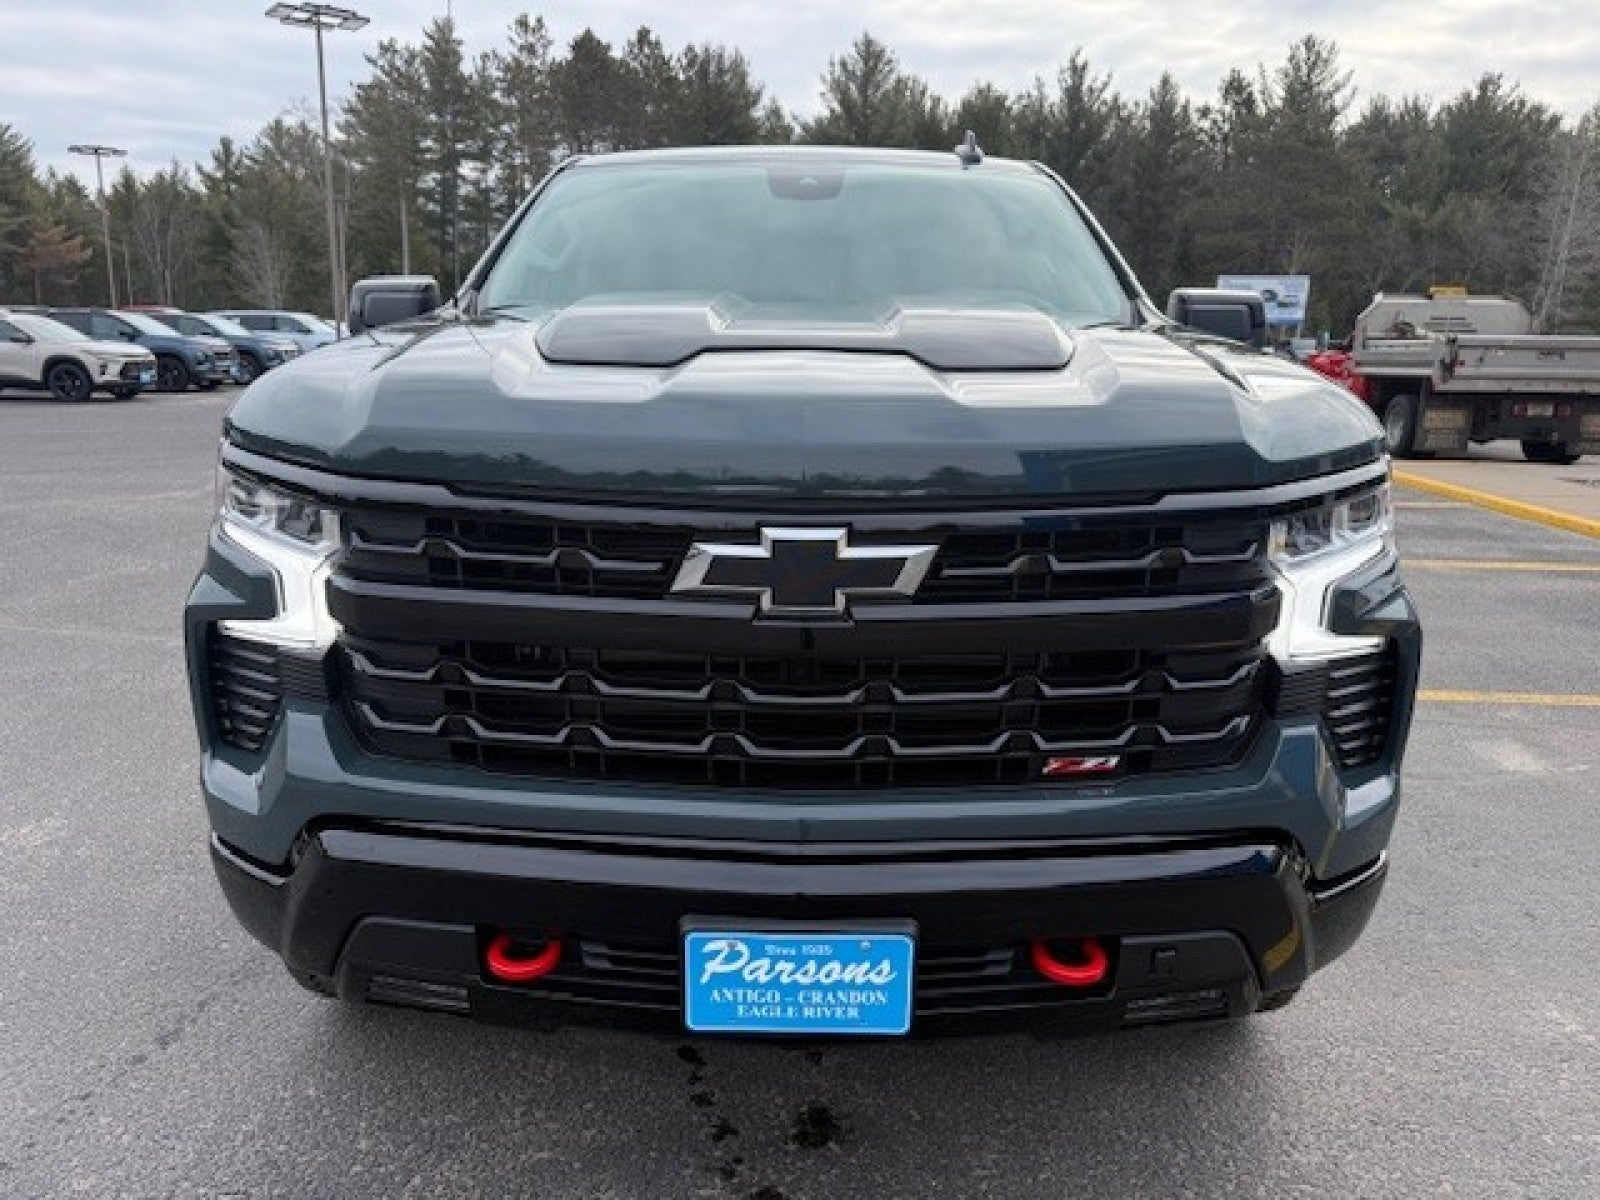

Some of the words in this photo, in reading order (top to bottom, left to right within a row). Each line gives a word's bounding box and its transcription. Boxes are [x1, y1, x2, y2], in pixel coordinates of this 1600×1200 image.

[701, 939, 898, 986] Parsons
[710, 988, 781, 1004] ANTIGO
[799, 989, 889, 1006] CRANDON
[737, 1004, 798, 1019] EAGLE
[803, 1005, 860, 1020] RIVER
